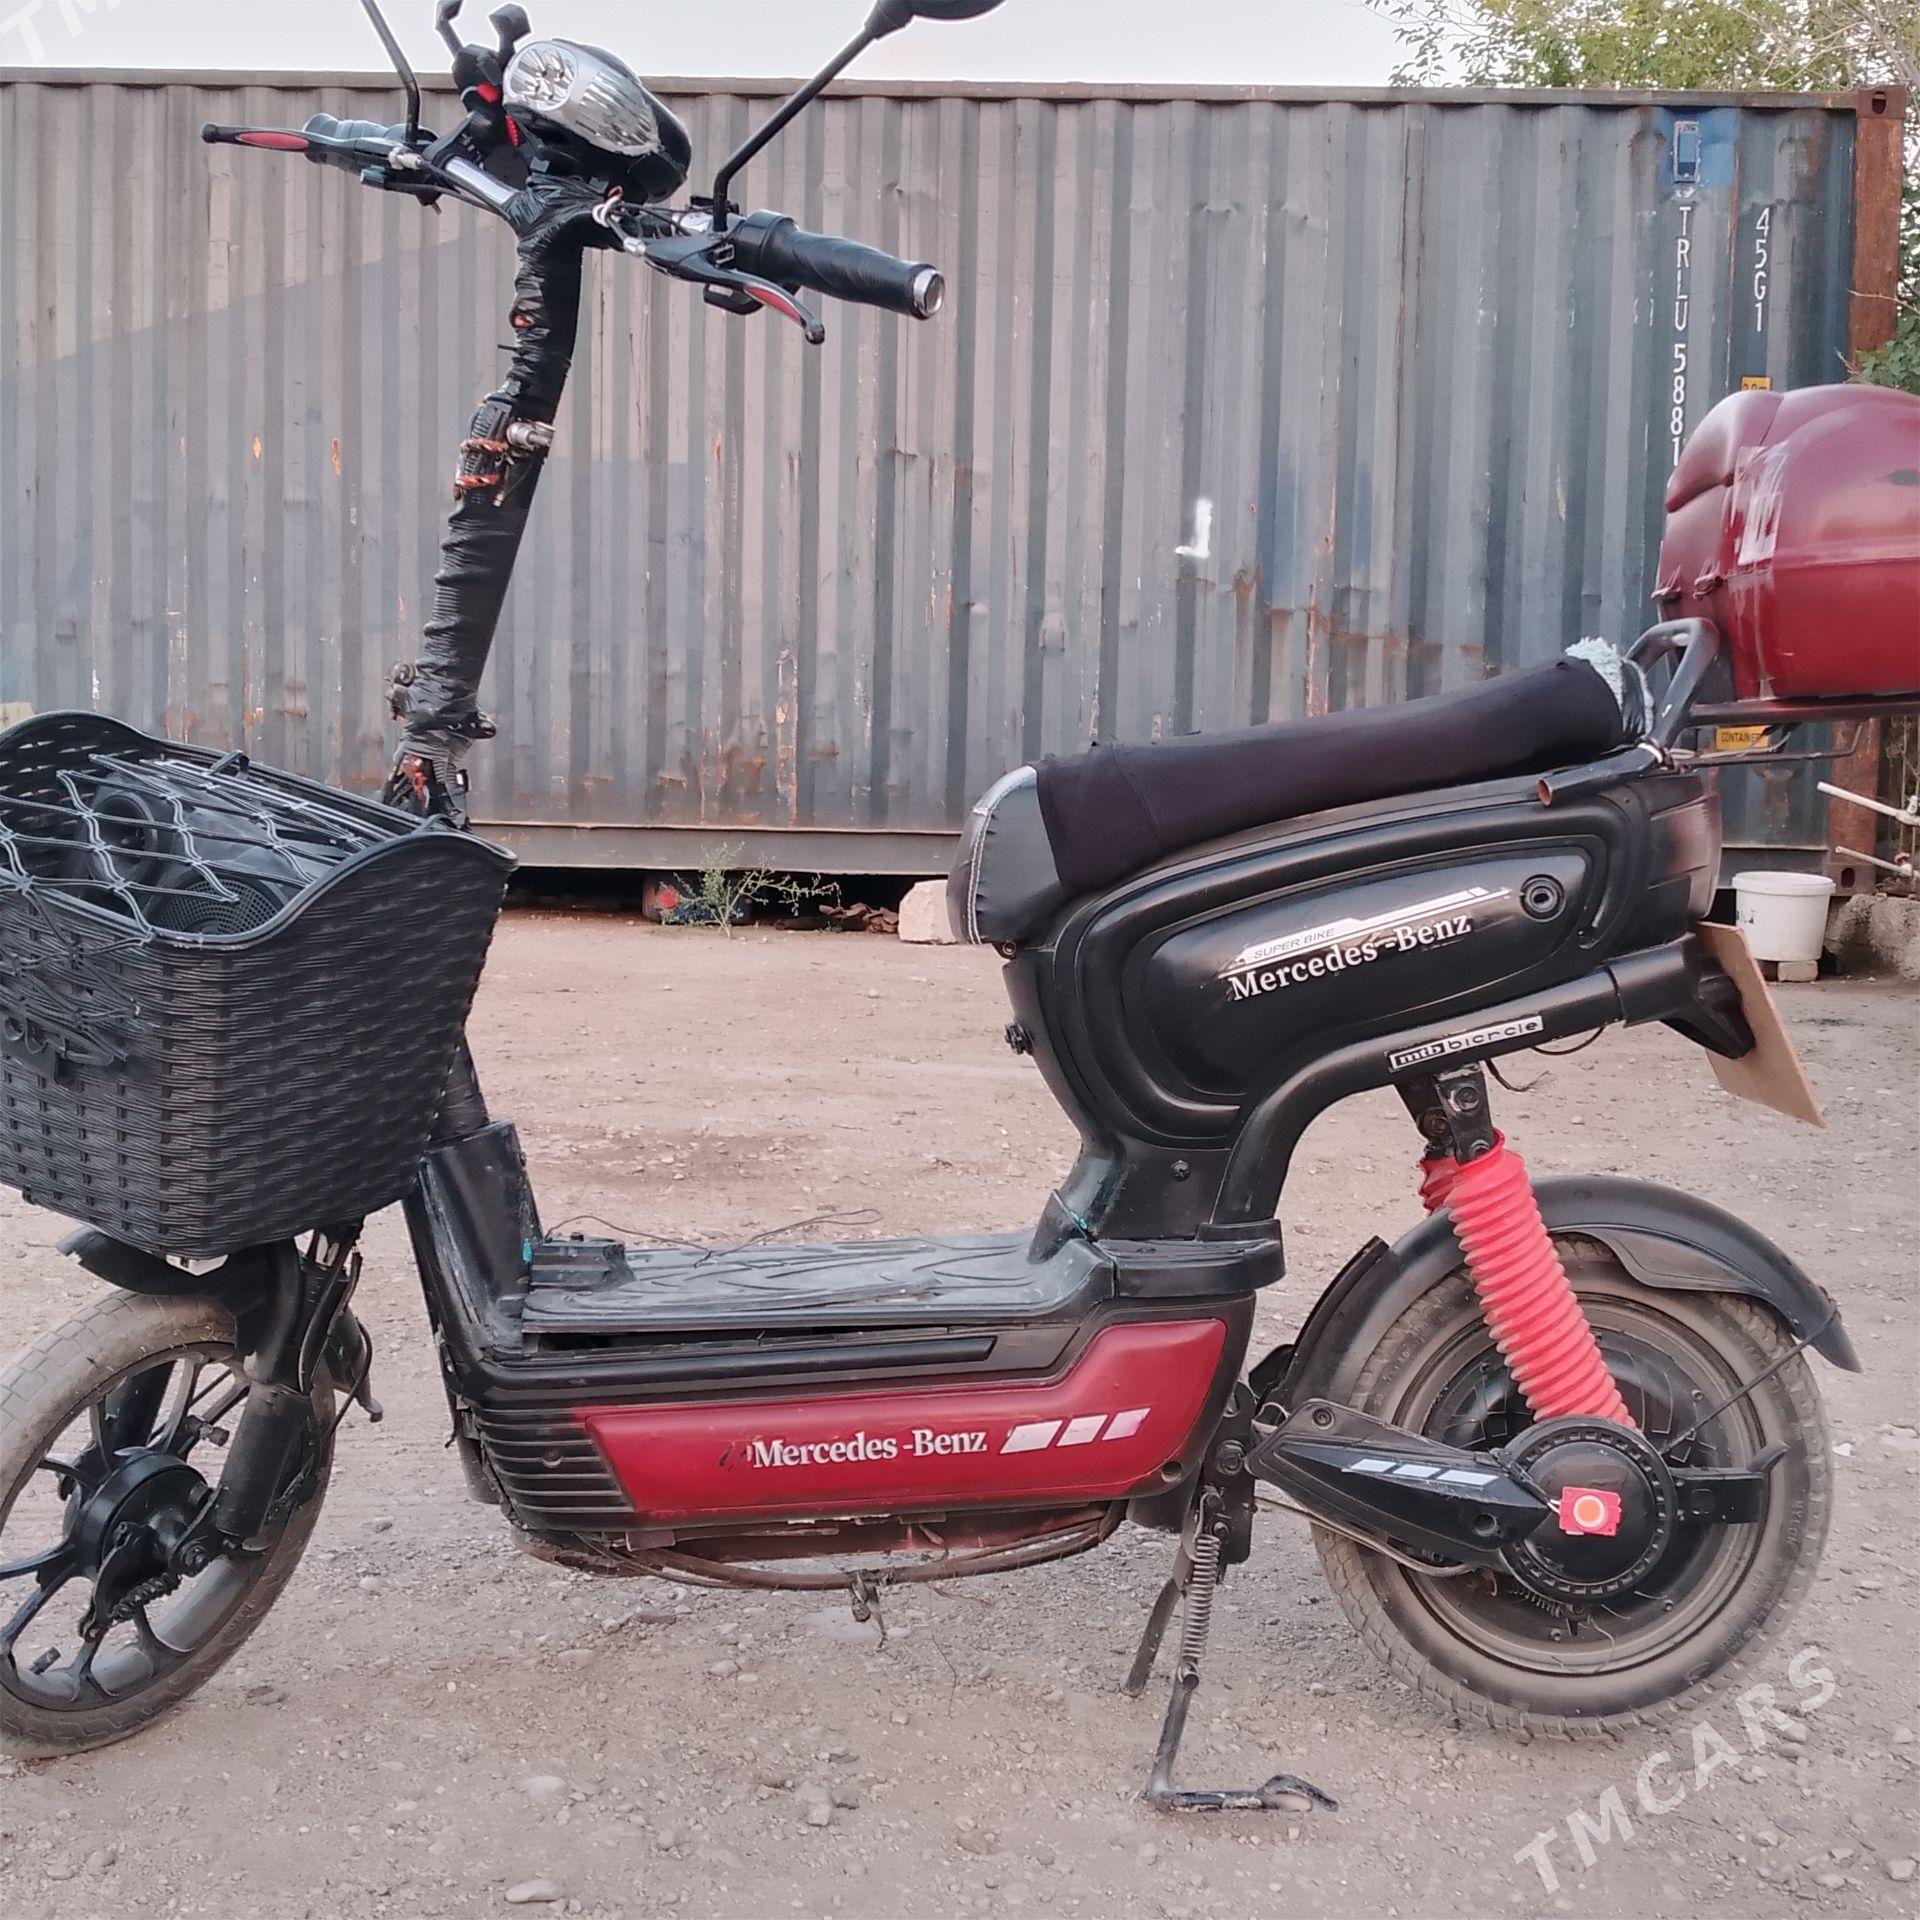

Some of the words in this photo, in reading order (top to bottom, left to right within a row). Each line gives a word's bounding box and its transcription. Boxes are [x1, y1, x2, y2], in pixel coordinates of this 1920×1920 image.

[1674, 206, 1691, 332] TRLU
[1753, 207, 1770, 332] 45G1
[1670, 343, 1686, 467] 5881
[1227, 914, 1472, 1001] Mercedes-Benz
[1253, 938, 1300, 960] SUPER
[1304, 927, 1336, 944] BIKE
[1399, 1042, 1443, 1065] mtb
